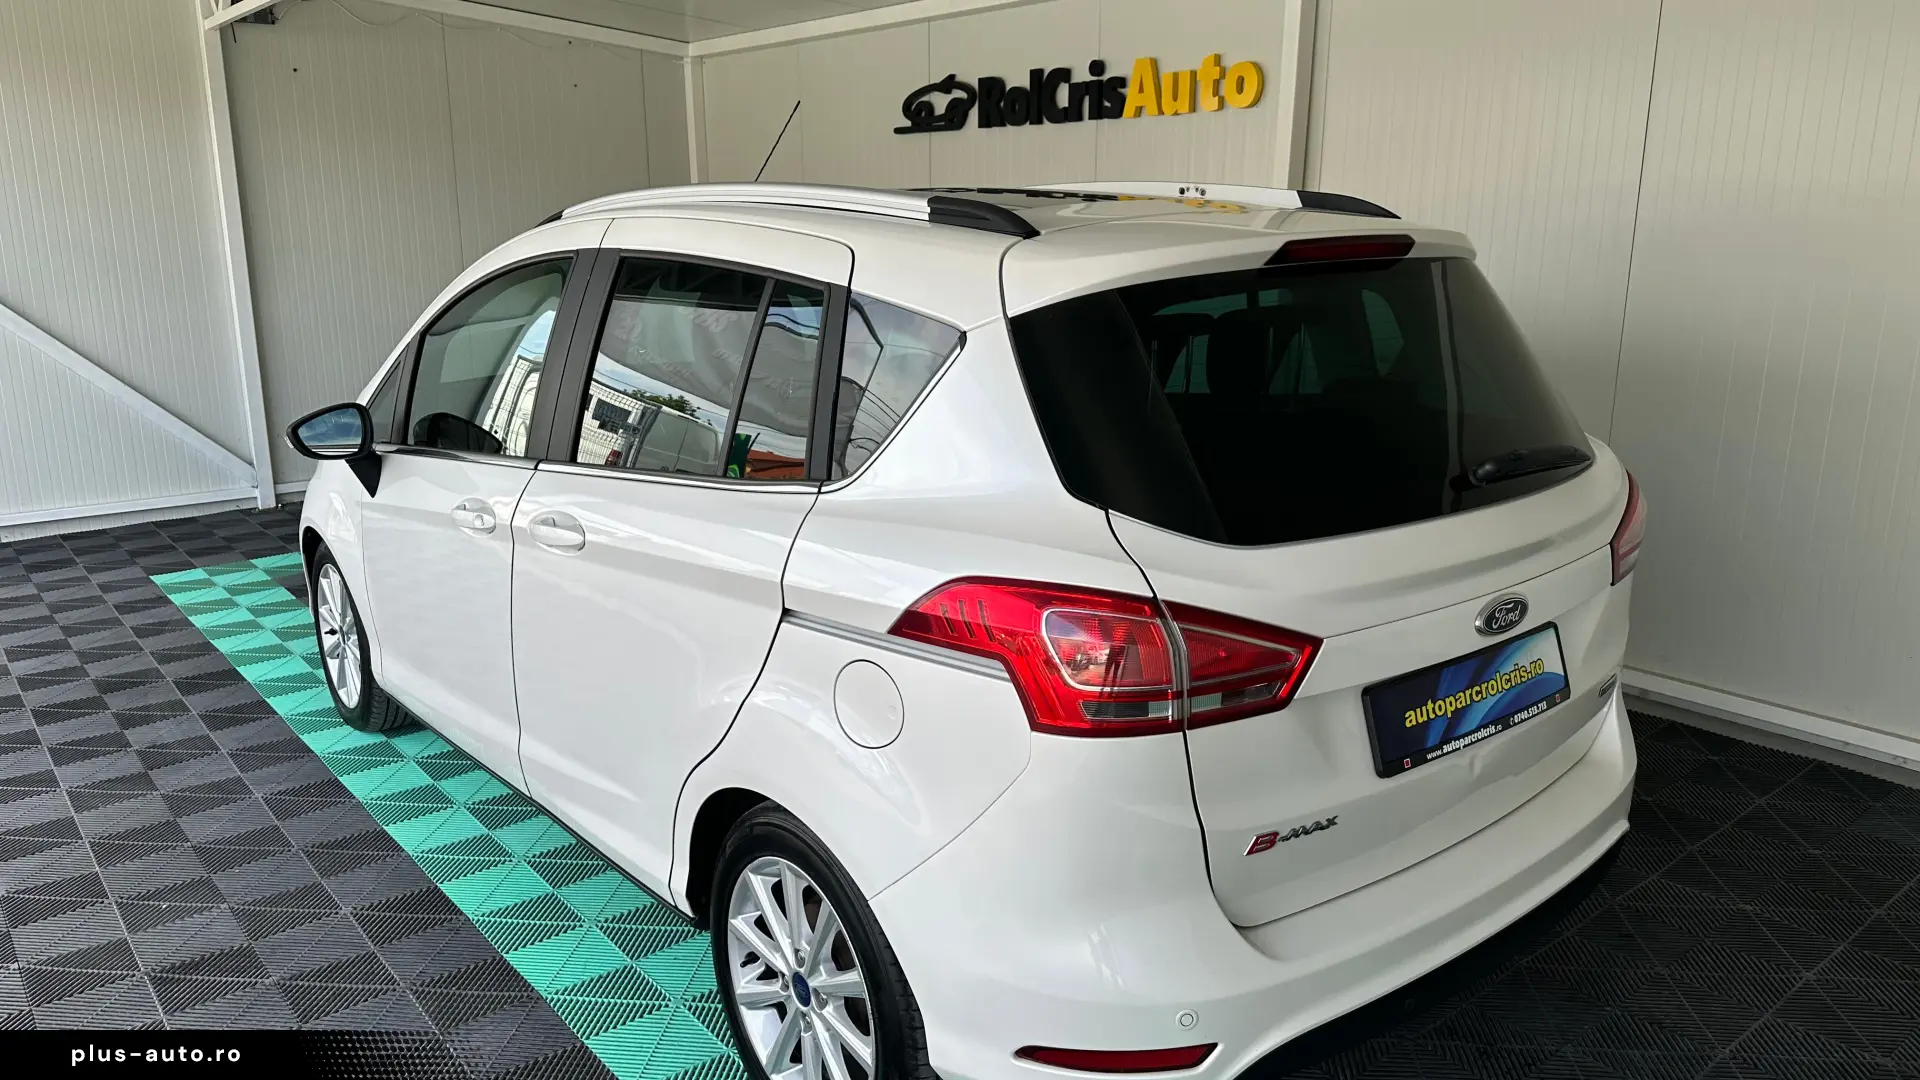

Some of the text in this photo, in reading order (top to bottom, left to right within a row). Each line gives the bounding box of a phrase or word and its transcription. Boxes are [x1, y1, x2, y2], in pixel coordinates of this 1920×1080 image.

[1492, 602, 1521, 629] Ford
[1404, 657, 1545, 728] autoparcrolcris.ro
[1426, 724, 1503, 760] www.autoparcrolcris.ro
